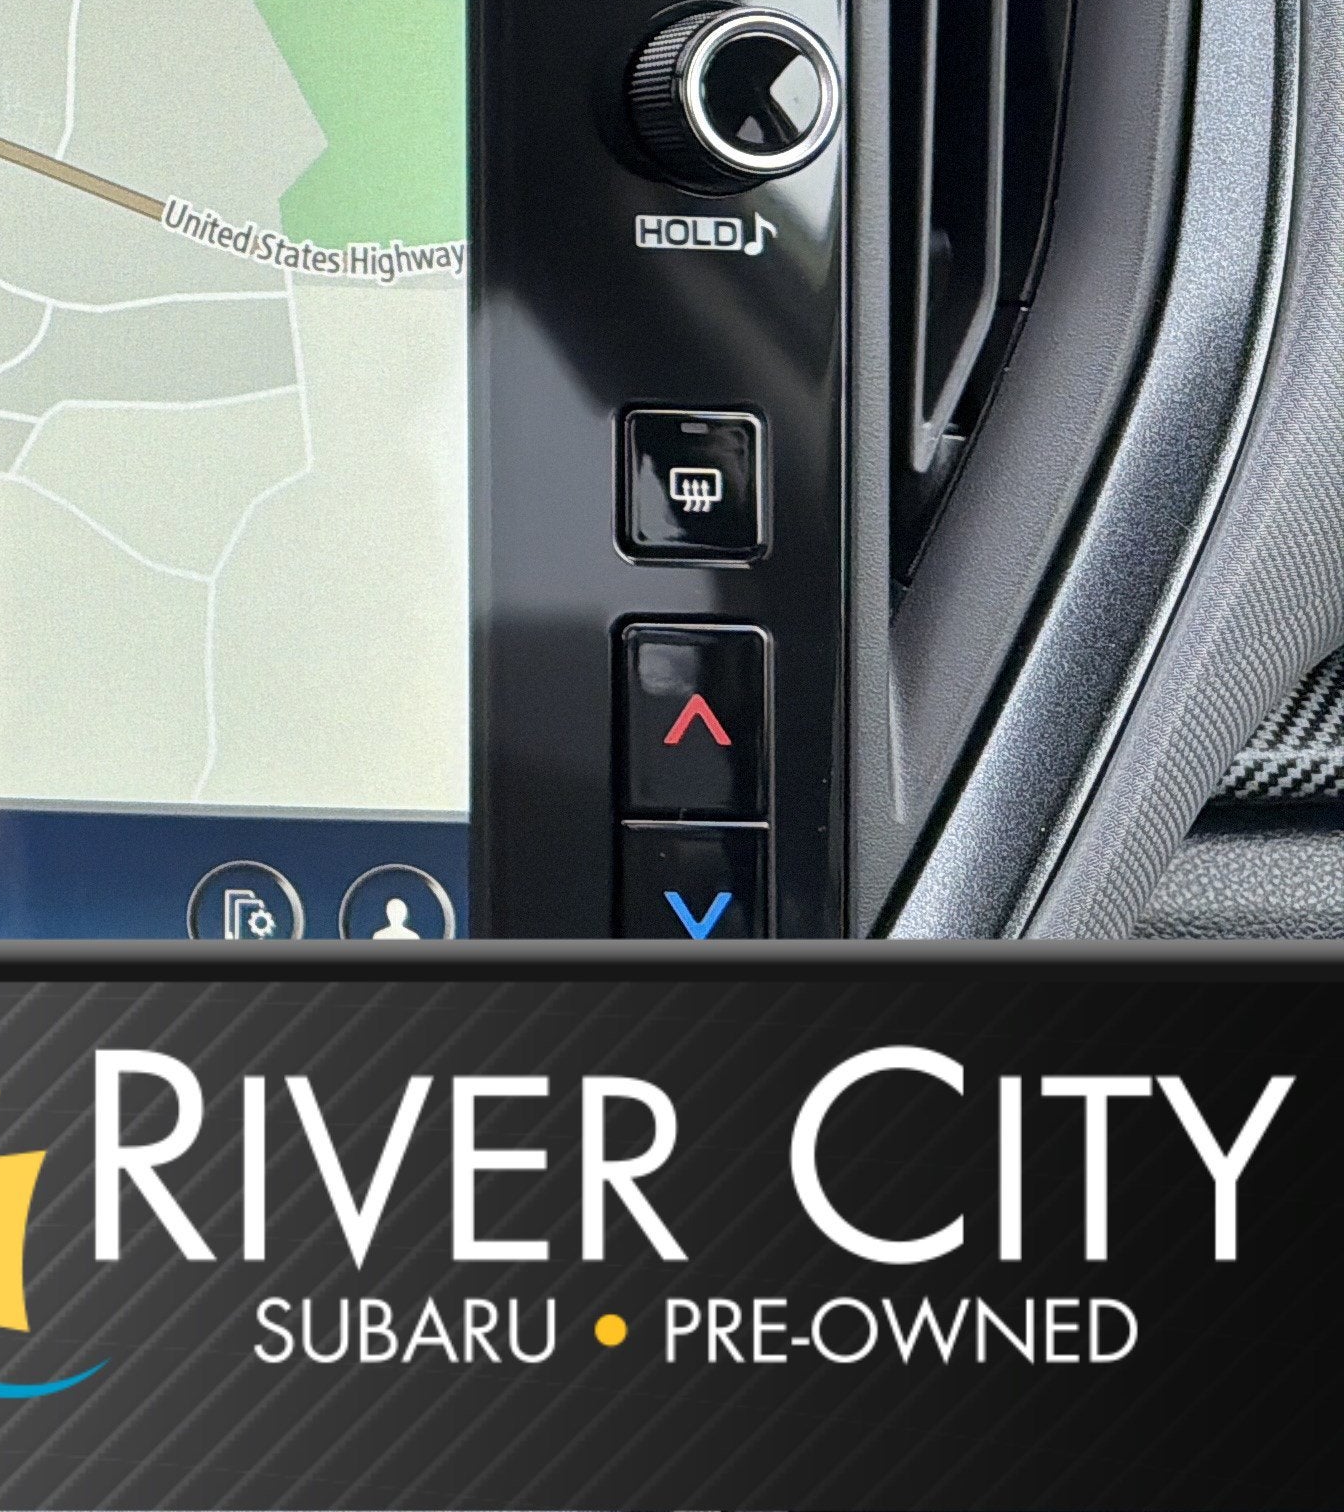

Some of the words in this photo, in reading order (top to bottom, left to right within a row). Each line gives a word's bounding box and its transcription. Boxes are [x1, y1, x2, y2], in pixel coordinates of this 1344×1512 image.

[165, 199, 252, 253] United
[257, 234, 340, 274] States
[350, 243, 465, 283] Highway
[637, 216, 740, 249] HOLD
